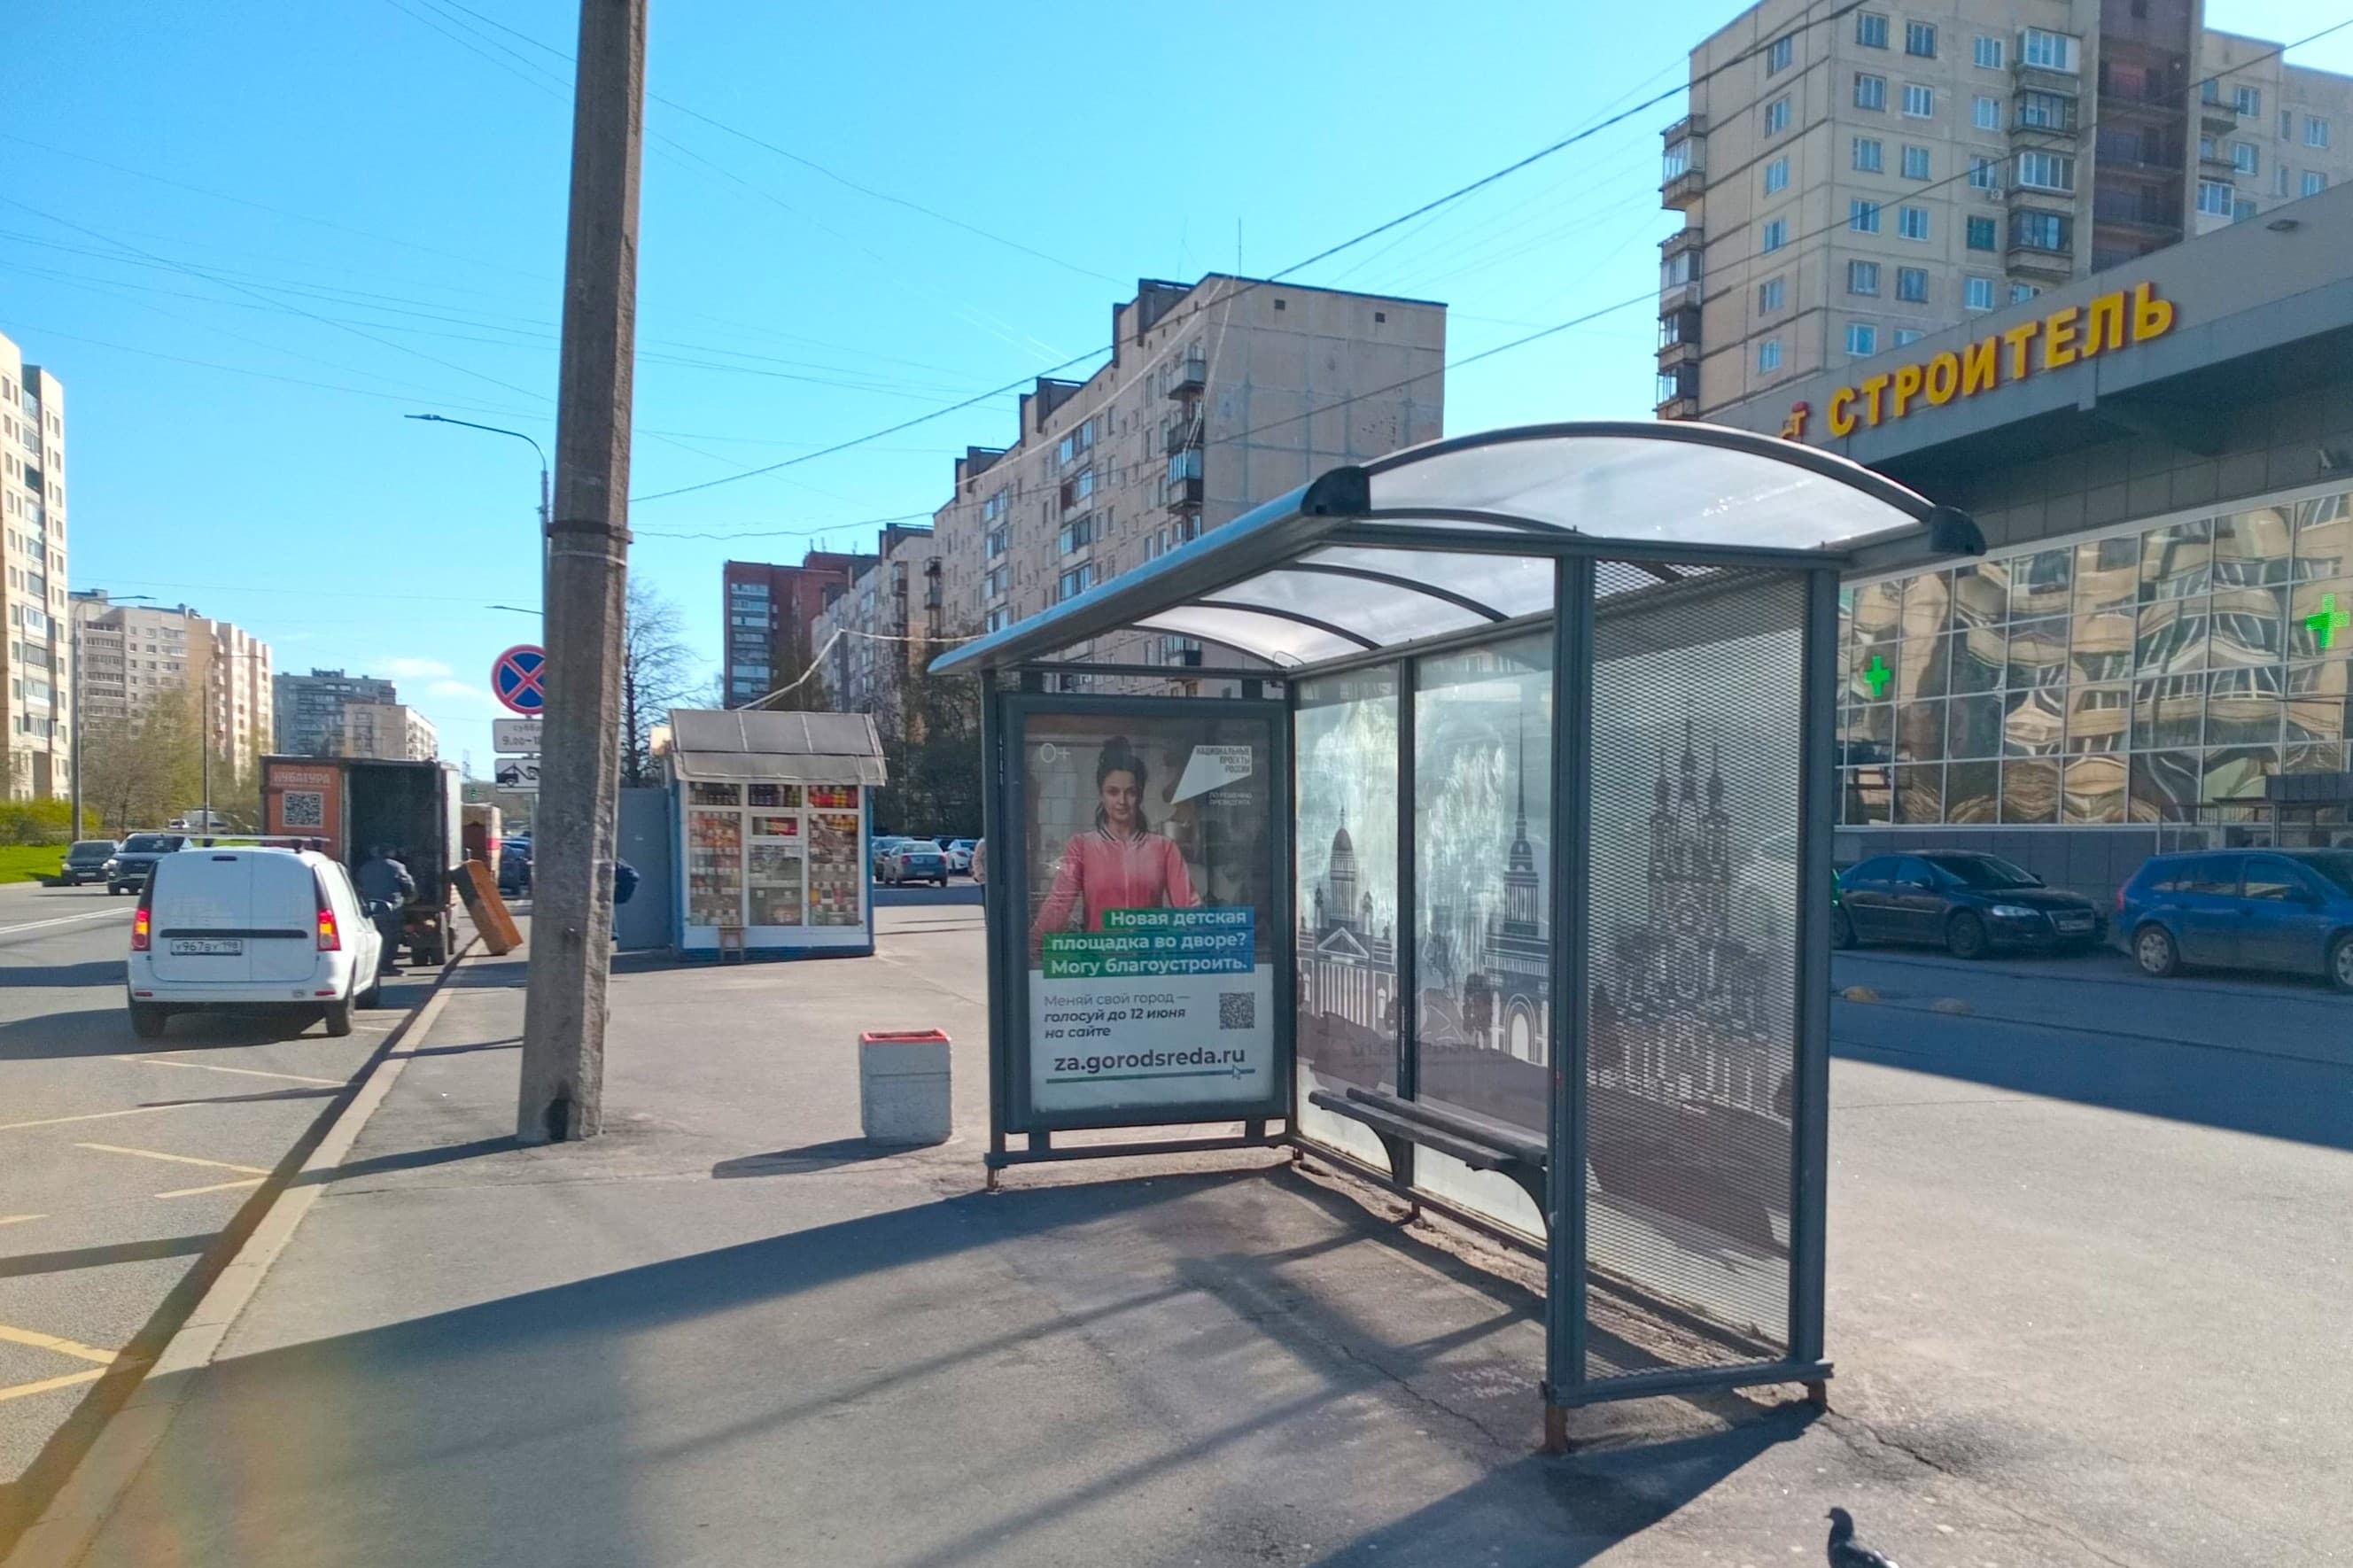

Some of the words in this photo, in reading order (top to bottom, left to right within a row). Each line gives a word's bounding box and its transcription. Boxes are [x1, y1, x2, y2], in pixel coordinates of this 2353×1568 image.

[1828, 282, 2177, 438] СТРОИТЕЛЬ
[1110, 912, 1169, 926] Новая
[1173, 911, 1246, 927] детская
[1052, 935, 1150, 951] площадка
[1154, 935, 1176, 949] во
[1181, 932, 1247, 951] дворе?
[1051, 959, 1100, 976] Могу
[1105, 956, 1247, 974] благоустроить.
[1044, 992, 1093, 1006] Меняй
[1096, 992, 1130, 1005] свой
[1133, 994, 1175, 1006] город
[1044, 1008, 1106, 1024] голосуй
[1107, 1011, 1127, 1021] до
[1130, 1008, 1144, 1020] 12
[1146, 1008, 1186, 1019] июня
[1044, 1029, 1064, 1039] на
[1068, 1024, 1112, 1038] сайте
[1053, 1047, 1246, 1074] za.gorodsreda.ru
